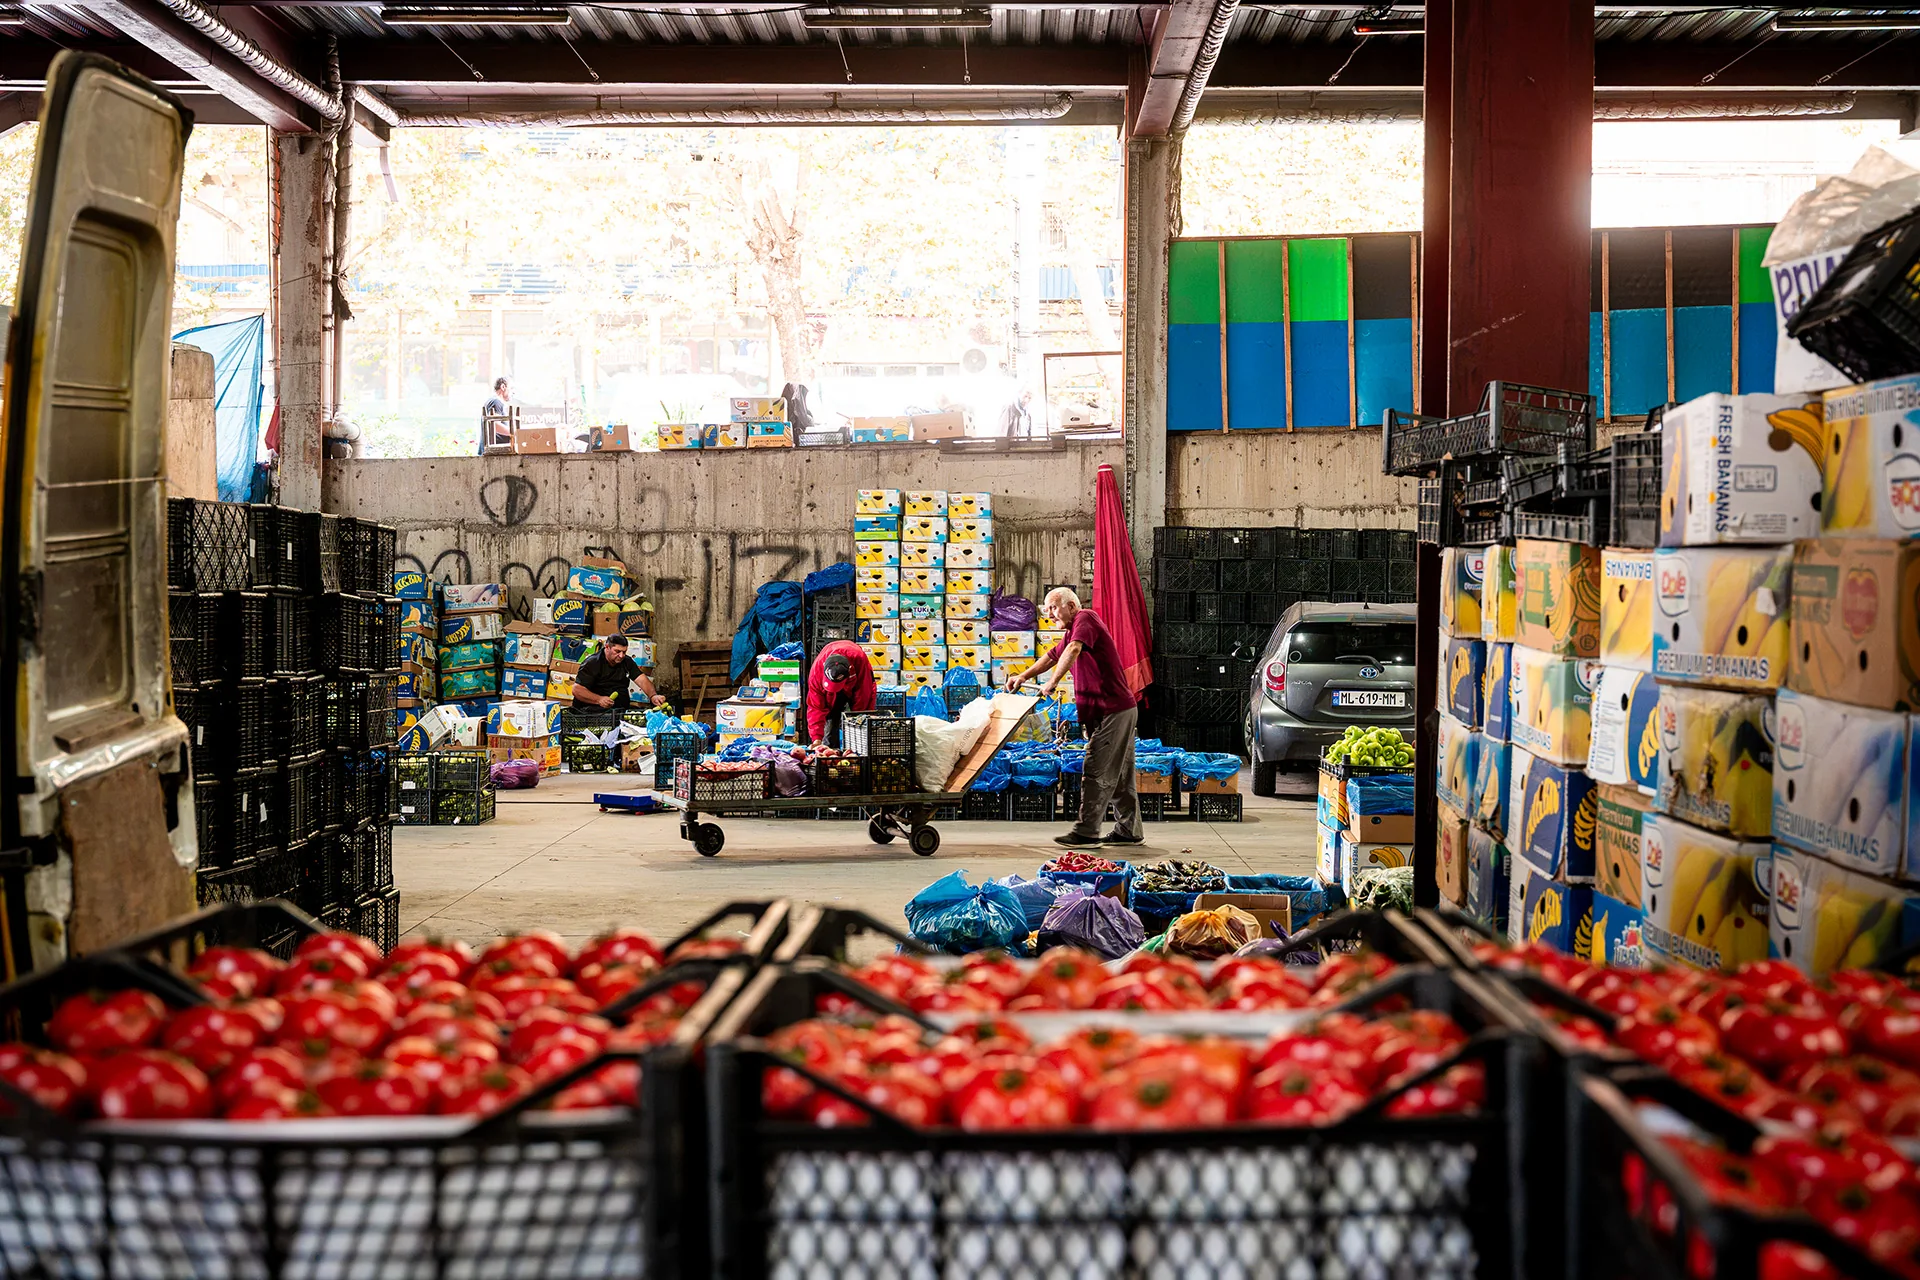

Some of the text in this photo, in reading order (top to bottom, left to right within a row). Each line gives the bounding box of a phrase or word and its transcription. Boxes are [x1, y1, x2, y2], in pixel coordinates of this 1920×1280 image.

[1717, 404, 1733, 455] FRESH
[1715, 458, 1732, 533] BANANAS
[1605, 560, 1652, 579] BANANAS
[1661, 571, 1687, 596] Dole
[1657, 652, 1770, 680] PREMIUM BANANAS
[1340, 693, 1396, 705] ML-619-MM
[1597, 824, 1639, 855] BANANAS
[1818, 822, 1880, 863] BANANAS
